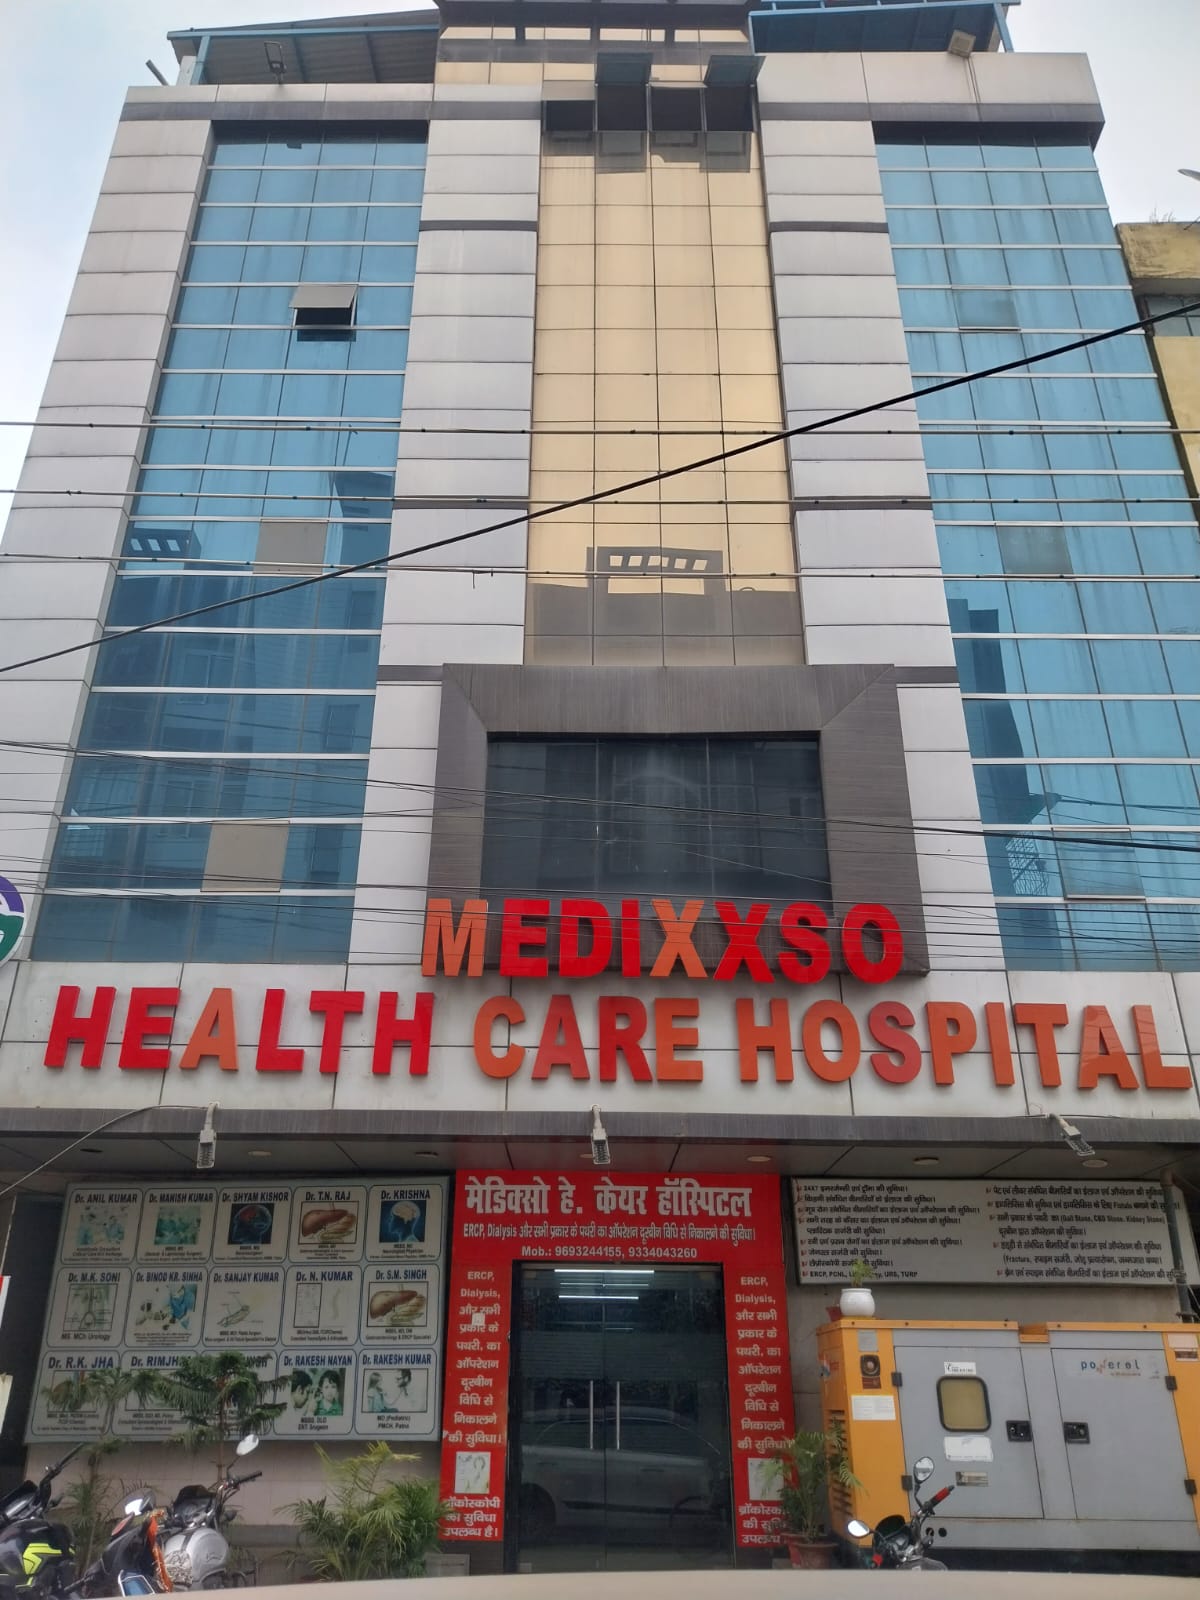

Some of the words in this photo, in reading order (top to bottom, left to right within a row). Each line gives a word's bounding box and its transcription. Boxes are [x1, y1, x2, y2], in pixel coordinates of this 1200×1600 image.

[421, 898, 904, 984] MEDIXXSO
[44, 986, 434, 1075] HEALTH
[474, 994, 703, 1082] CARE
[736, 998, 1192, 1089] HOSPITAL
[87, 1194, 106, 1203] ANIL
[108, 1193, 138, 1203] KUMAR
[159, 1193, 187, 1203] MANISH
[188, 1193, 213, 1202] KUMAR
[233, 1192, 259, 1202] SHYAM
[260, 1191, 289, 1201] KISHOR
[305, 1191, 316, 1201] Dr.
[318, 1191, 333, 1201] T.N.
[335, 1191, 351, 1201] RAJ
[381, 1189, 392, 1200] Dr.
[393, 1189, 431, 1199] KRISHNA
[465, 1176, 551, 1214] मेडिक्सो
[558, 1176, 583, 1214] हे.
[593, 1176, 648, 1215] केयर
[656, 1177, 752, 1217] हॉस्पिटल
[463, 1223, 485, 1240] ERCP,
[487, 1224, 516, 1240] Dialysis
[520, 1220, 532, 1238] और
[534, 1221, 548, 1238] सभी
[550, 1225, 568, 1239] प्रकार
[570, 1222, 578, 1238] के
[580, 1221, 595, 1238] पथरी
[597, 1225, 607, 1238] का
[609, 1222, 638, 1239] ऑपरेशन
[663, 1222, 678, 1239] विधि
[680, 1224, 687, 1239] से
[688, 1223, 718, 1240] निकालने
[720, 1223, 729, 1240] की
[522, 1245, 551, 1257] Mob.:
[555, 1246, 625, 1259] 9693244155,
[628, 1246, 697, 1258] 9334043260
[68, 1272, 78, 1282] Dr.
[80, 1272, 98, 1282] M.K.
[101, 1272, 121, 1282] SONI
[146, 1272, 168, 1282] BINOD
[182, 1272, 203, 1282] SINHA
[224, 1272, 251, 1282] SANJAY
[253, 1272, 279, 1282] KUMAR
[296, 1272, 307, 1282] Dr.
[309, 1271, 319, 1281] N.
[320, 1271, 353, 1281] KUMAR
[375, 1270, 385, 1280] Dr.
[387, 1270, 402, 1280] S.M.
[403, 1270, 427, 1280] SINGH
[467, 1271, 495, 1282] ERCP,
[740, 1276, 768, 1287] ERCP,
[460, 1288, 501, 1300] Dialysis,
[735, 1294, 776, 1305] Dialysis,
[479, 1304, 500, 1315] सभी
[735, 1311, 755, 1321] और
[756, 1310, 777, 1321] सभी
[488, 1321, 499, 1333] के
[737, 1329, 764, 1341] प्रकार
[766, 1327, 777, 1339] के
[486, 1341, 501, 1351] का
[767, 1347, 781, 1357] का
[48, 1357, 62, 1368] Dr.
[65, 1357, 88, 1368] R.K.
[91, 1356, 114, 1368] JHA
[131, 1356, 144, 1367] Dr.
[283, 1356, 293, 1366] Dr.
[295, 1355, 325, 1366] RAKESH
[327, 1355, 352, 1366] NAYAN
[362, 1355, 371, 1365] Dr.
[373, 1354, 403, 1365] RAKESH
[404, 1354, 432, 1365] KUMAR
[456, 1357, 499, 1369] ऑपरेशन
[738, 1363, 781, 1375] ऑपरेशन
[461, 1375, 493, 1391] दूरबीन
[744, 1381, 777, 1397] दूरबीन
[459, 1393, 481, 1406] विधि
[483, 1394, 493, 1406] से
[744, 1399, 766, 1412] विधि
[769, 1400, 780, 1412] से
[454, 1413, 497, 1425] निकालने
[741, 1418, 785, 1431] निकालने
[448, 1430, 463, 1443] की
[737, 1436, 752, 1449] की
[464, 1510, 497, 1526] सुविधा
[742, 1516, 758, 1529] की
